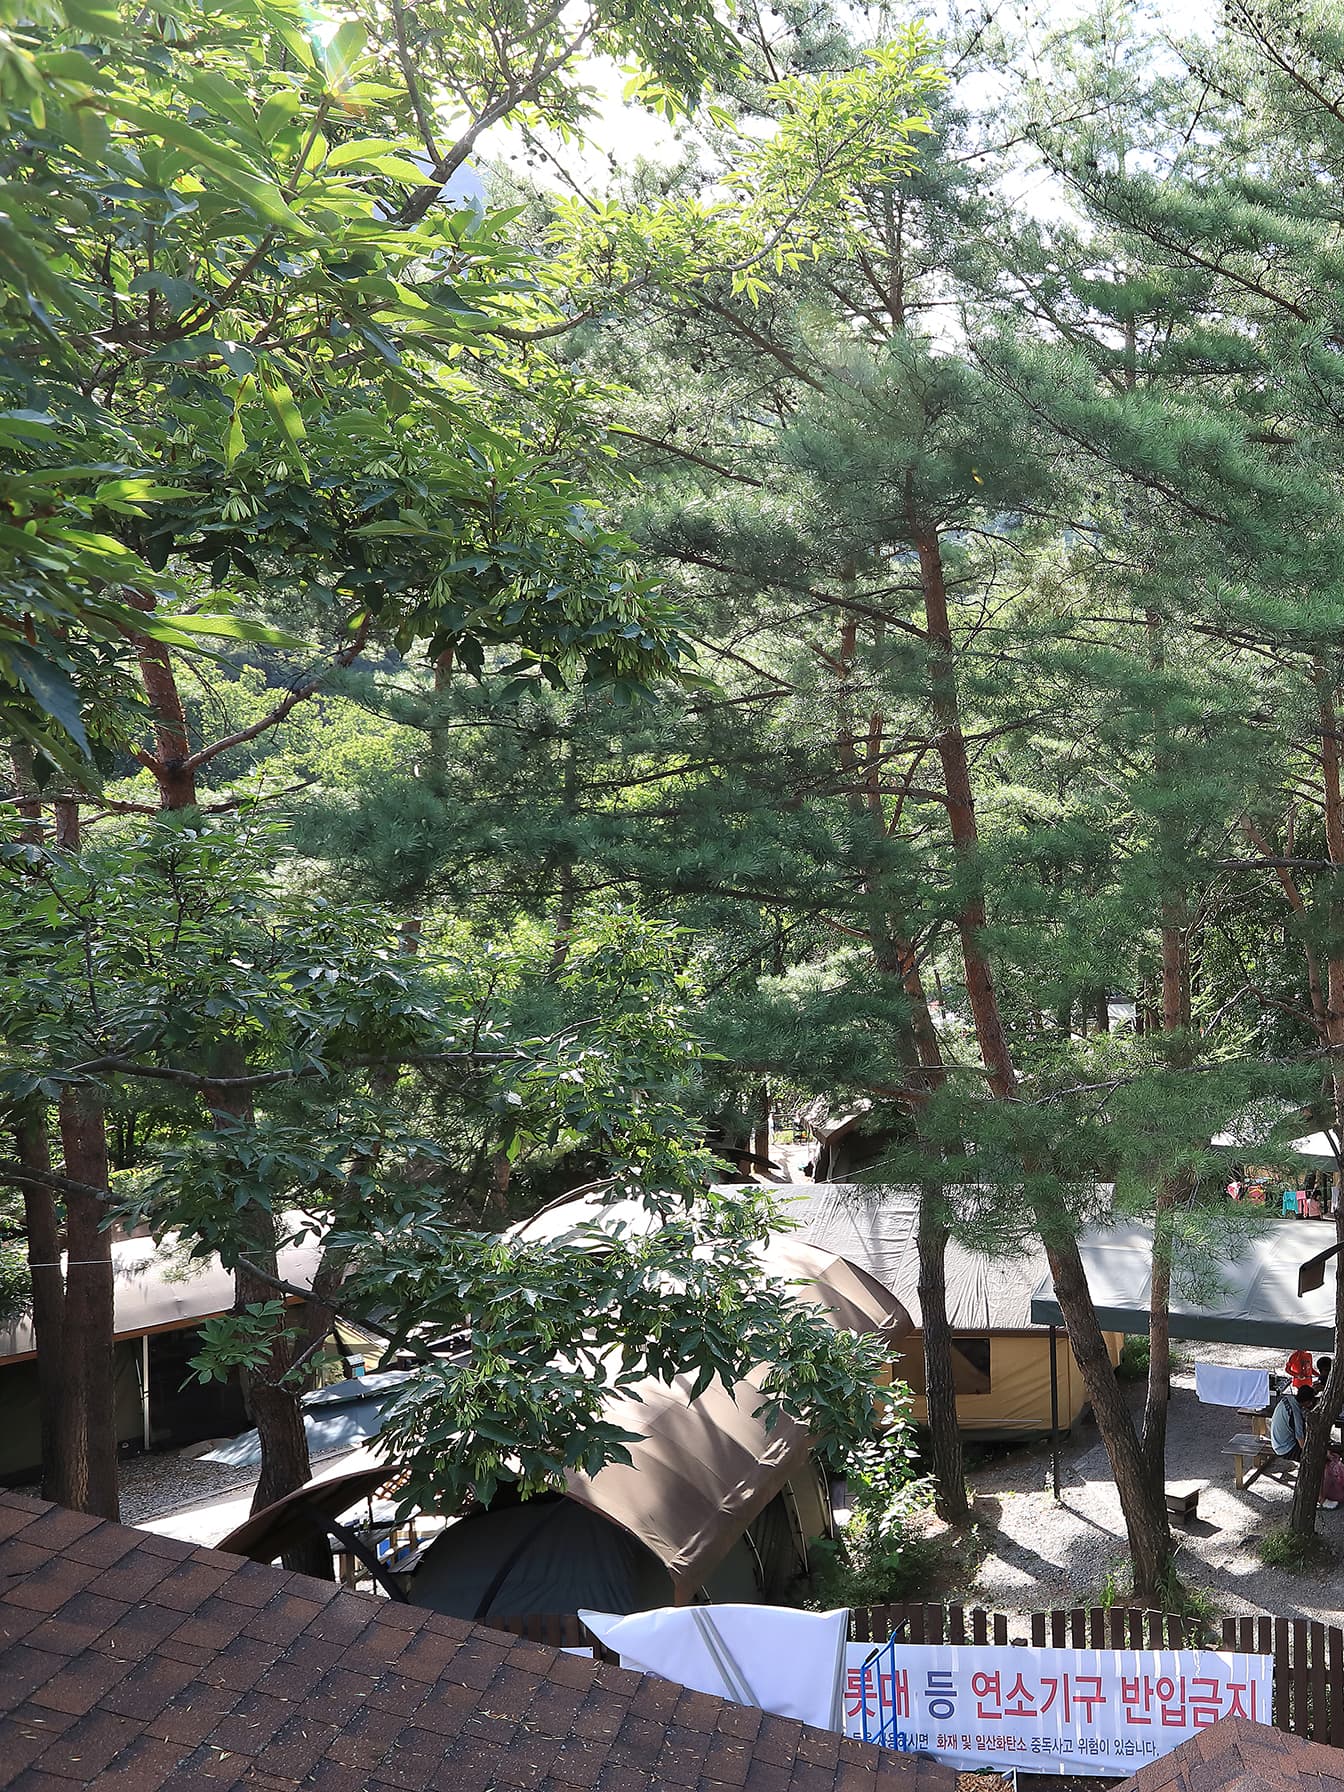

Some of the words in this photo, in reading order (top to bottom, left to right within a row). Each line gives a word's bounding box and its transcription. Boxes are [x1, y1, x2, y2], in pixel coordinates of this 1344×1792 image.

[924, 1670, 957, 1720] 등
[971, 1670, 1107, 1724] 연소기구
[1121, 1675, 1257, 1728] 반입금지
[936, 1734, 958, 1751] 화재
[961, 1735, 971, 1751] 및
[975, 1735, 1027, 1752] 일산화탄소
[1030, 1736, 1073, 1755] 중독사고
[1078, 1737, 1110, 1756] 위험이
[1114, 1739, 1160, 1757] 있습니다.
